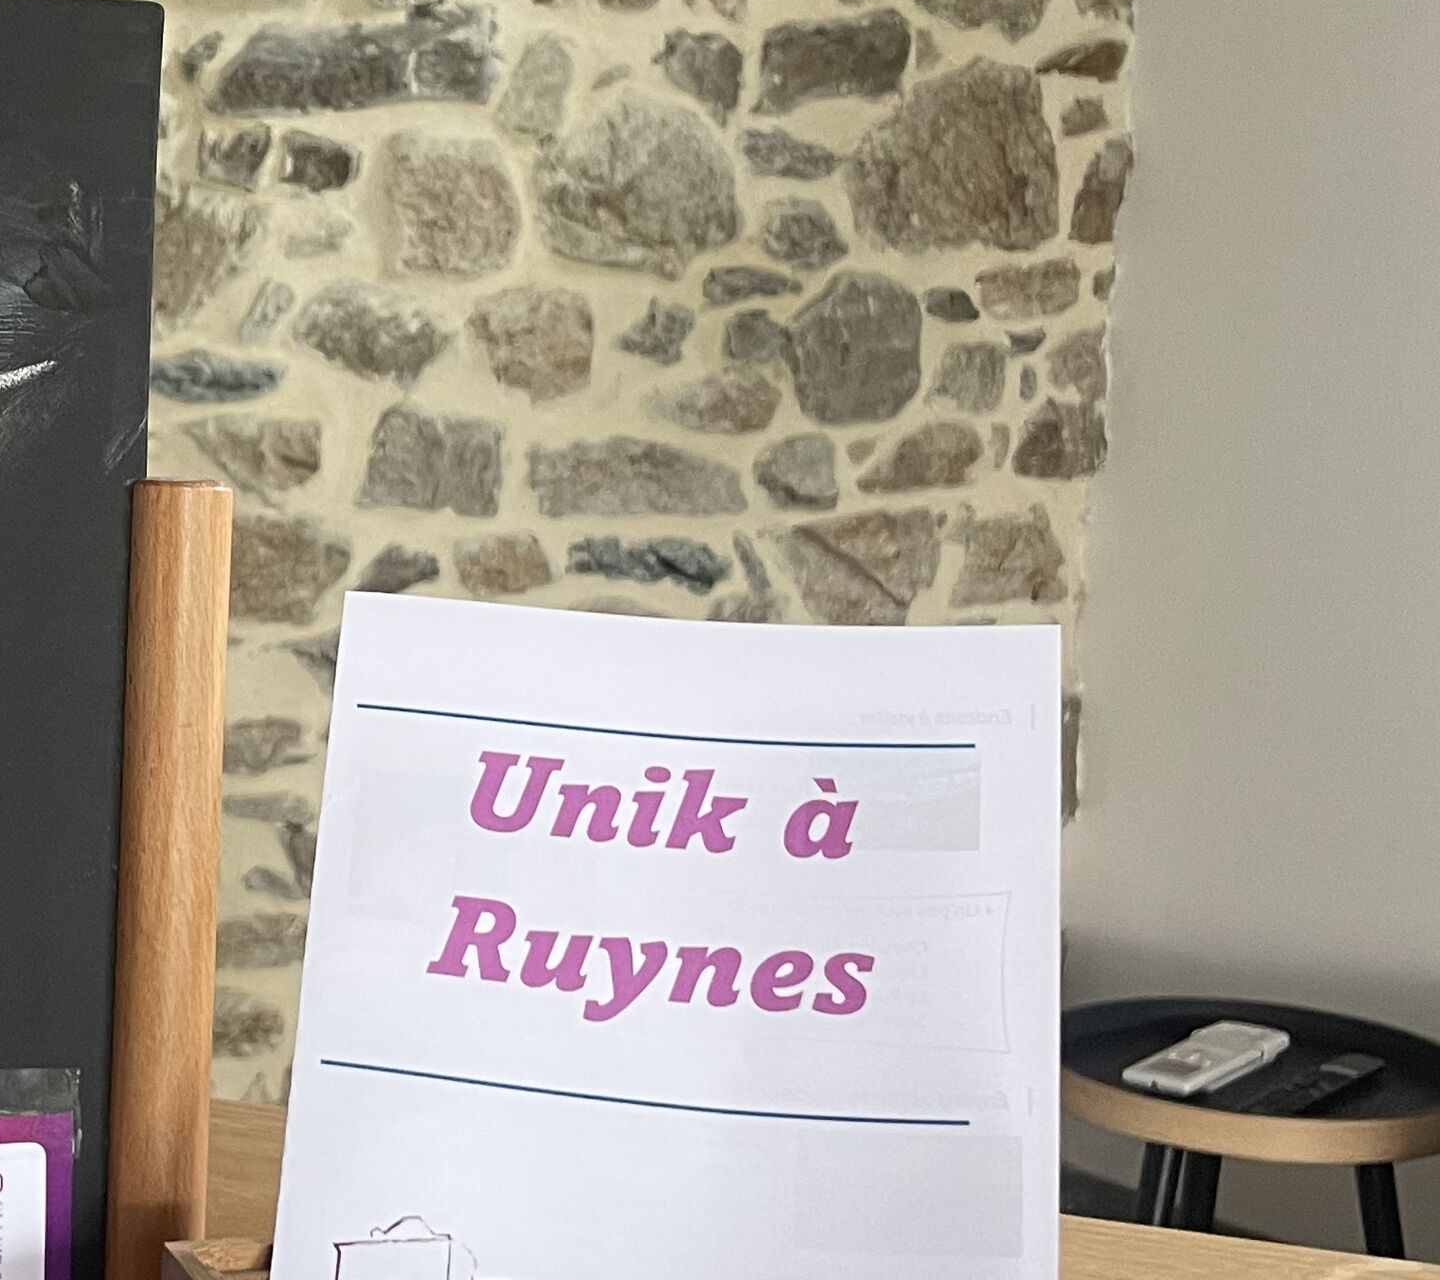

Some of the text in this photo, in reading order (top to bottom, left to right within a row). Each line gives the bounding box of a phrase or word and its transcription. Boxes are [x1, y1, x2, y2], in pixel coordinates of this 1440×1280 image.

[469, 750, 860, 860] Unik à
[426, 894, 875, 1022] Ruynes
